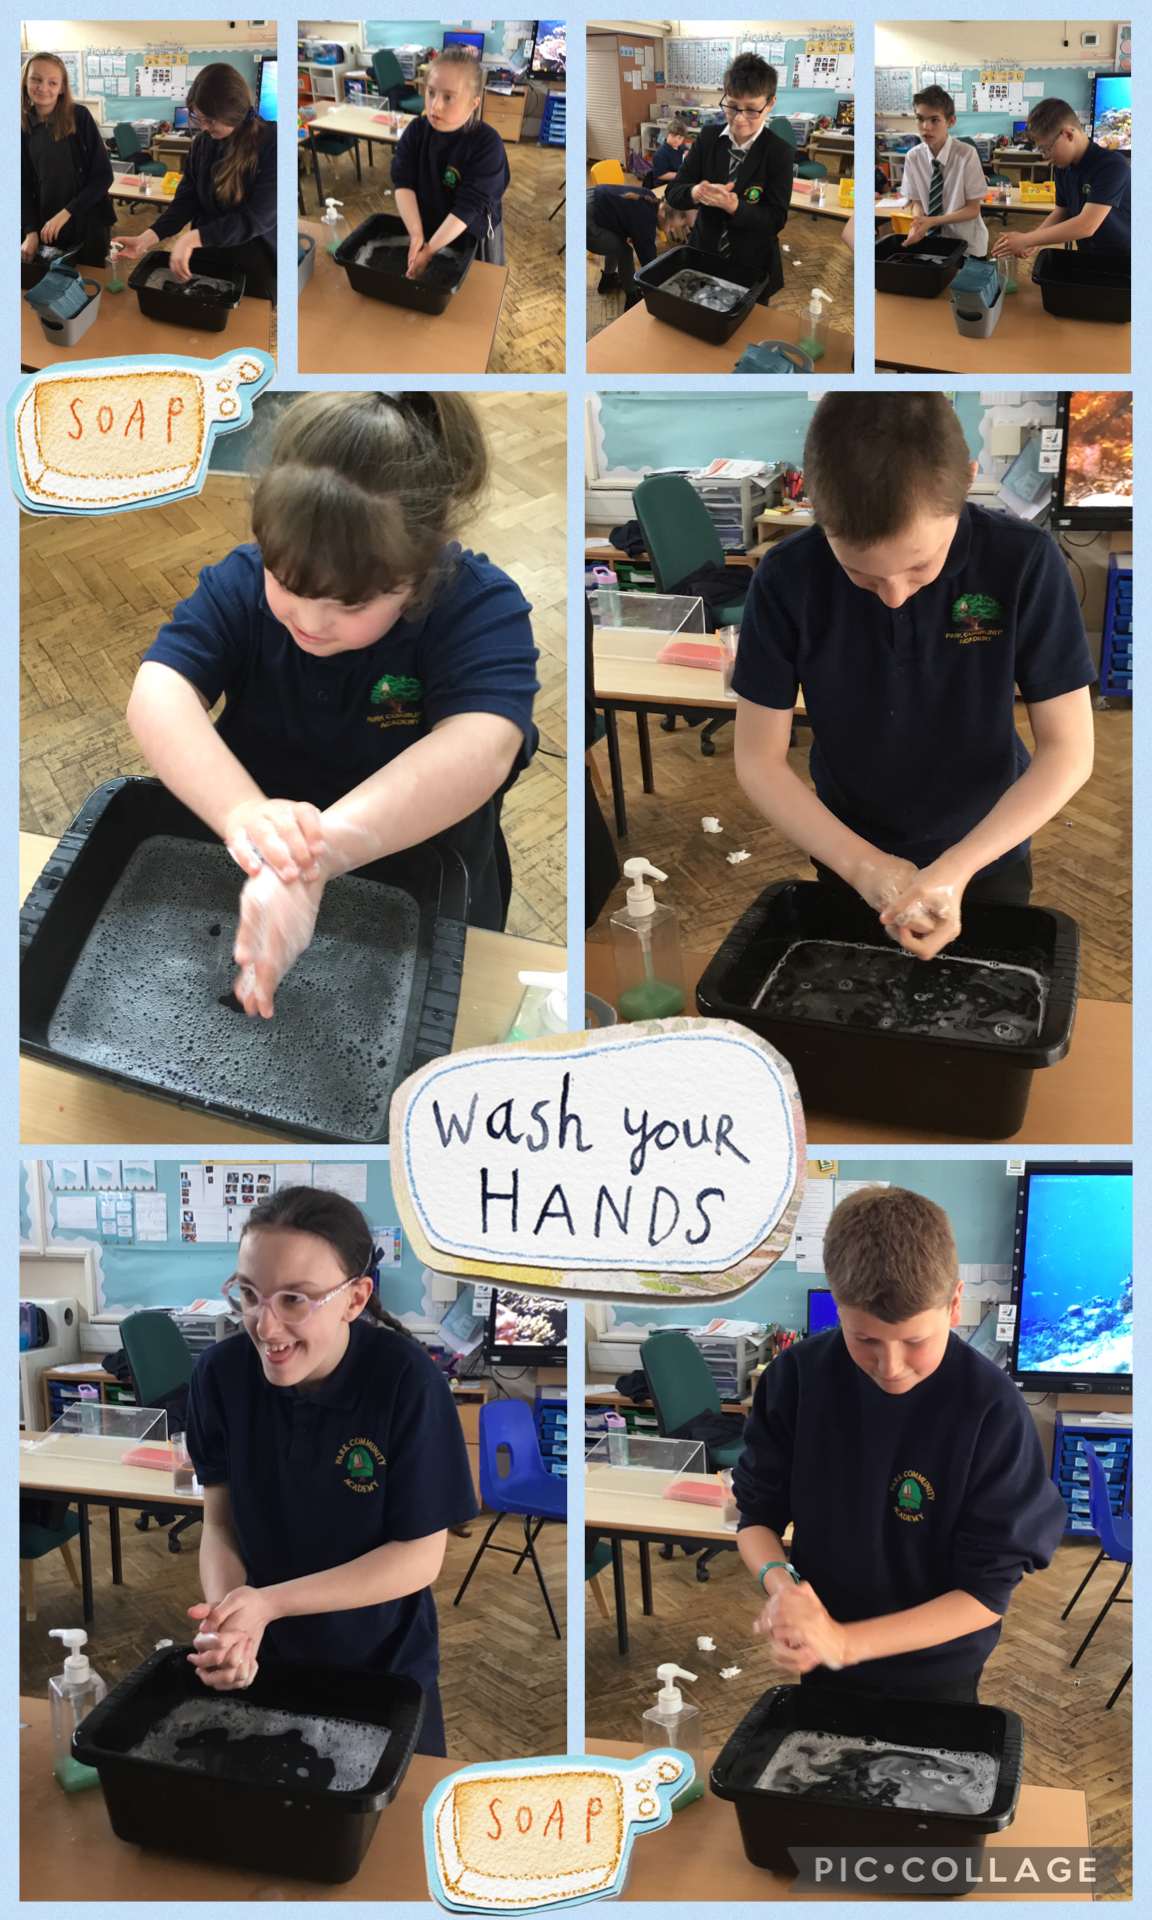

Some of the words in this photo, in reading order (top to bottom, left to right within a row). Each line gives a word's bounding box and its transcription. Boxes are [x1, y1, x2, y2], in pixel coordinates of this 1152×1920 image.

[335, 1443, 351, 1466] PARK
[349, 1436, 387, 1467] COMMUNITY
[343, 1478, 379, 1493] ACADEMY
[903, 1469, 936, 1502] COMMUNITY
[893, 1505, 925, 1523] ACADEMY
